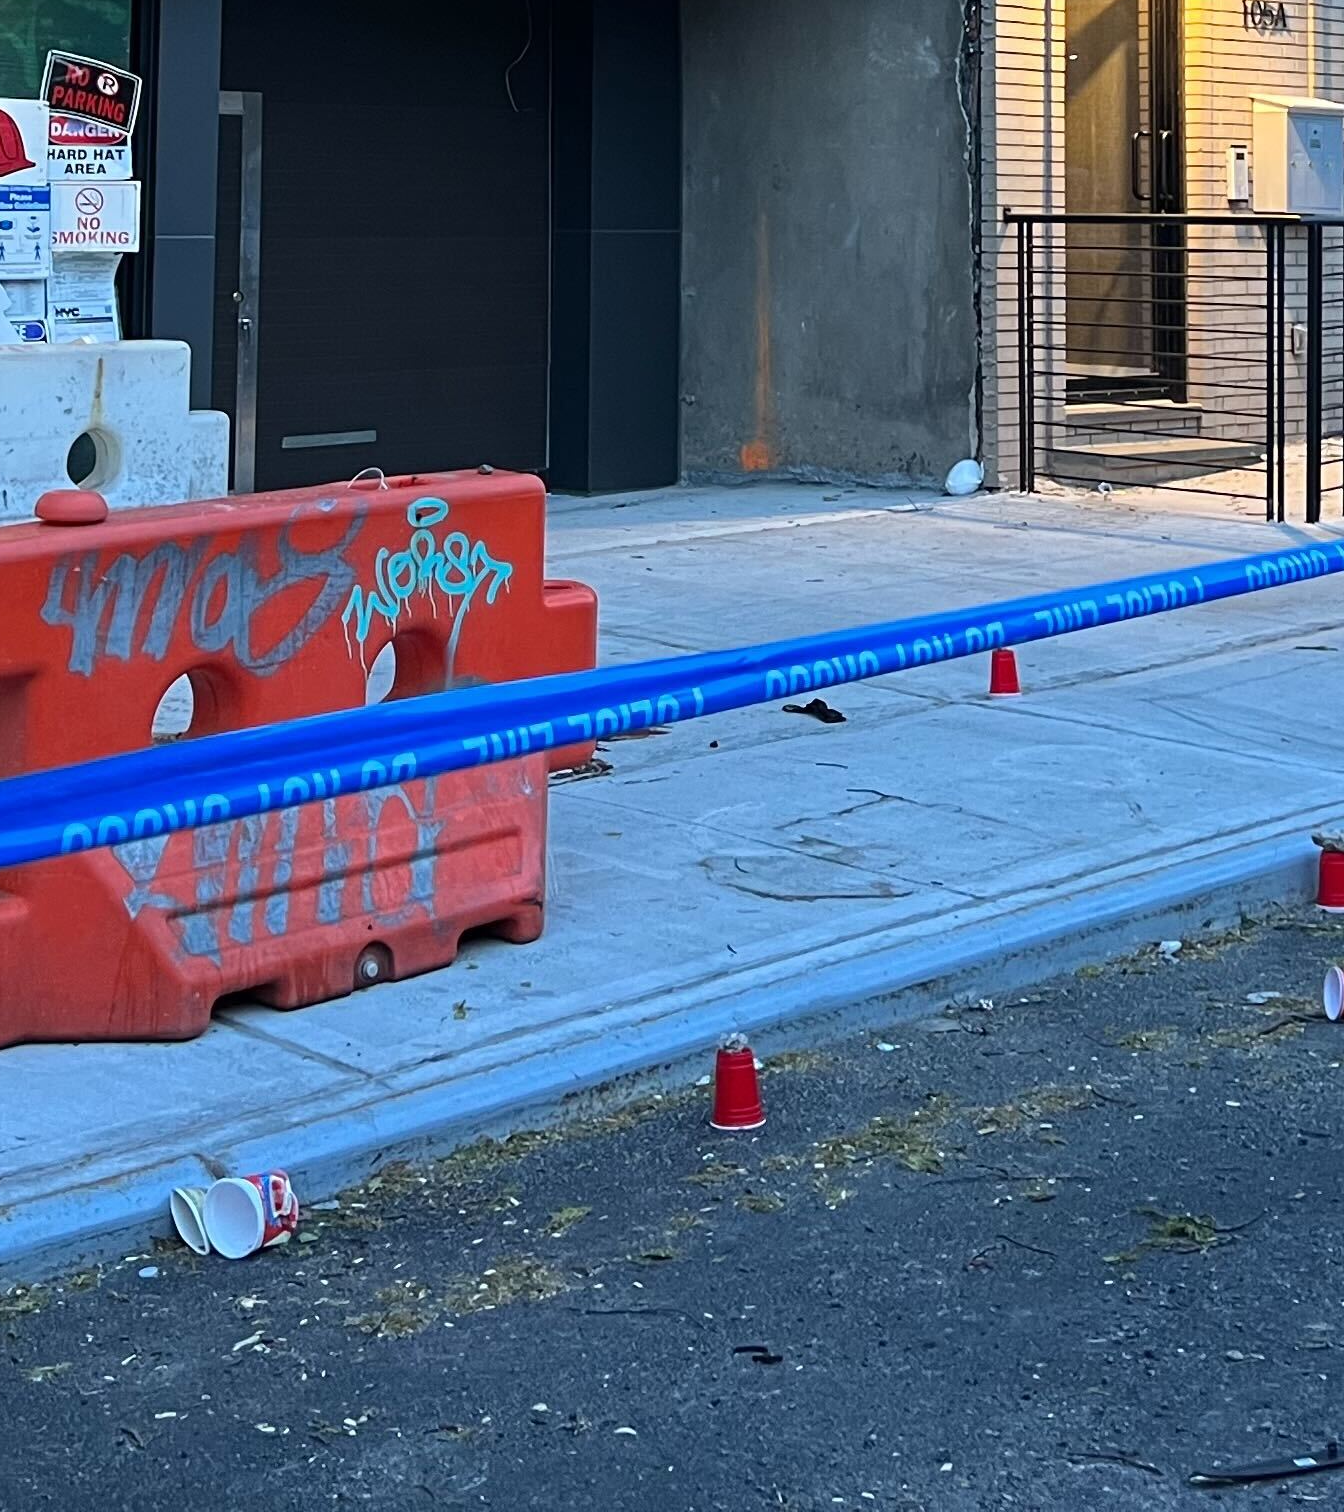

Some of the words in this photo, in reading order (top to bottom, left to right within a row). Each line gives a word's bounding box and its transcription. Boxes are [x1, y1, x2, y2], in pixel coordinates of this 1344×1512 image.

[1242, 0, 1287, 32] 105A
[65, 64, 90, 86] NO
[51, 85, 125, 123] PARKING
[47, 149, 87, 160] HARD
[93, 149, 125, 160] HAT
[64, 163, 106, 174] AREA
[77, 217, 100, 230] NO
[51, 231, 129, 244] SMOKING
